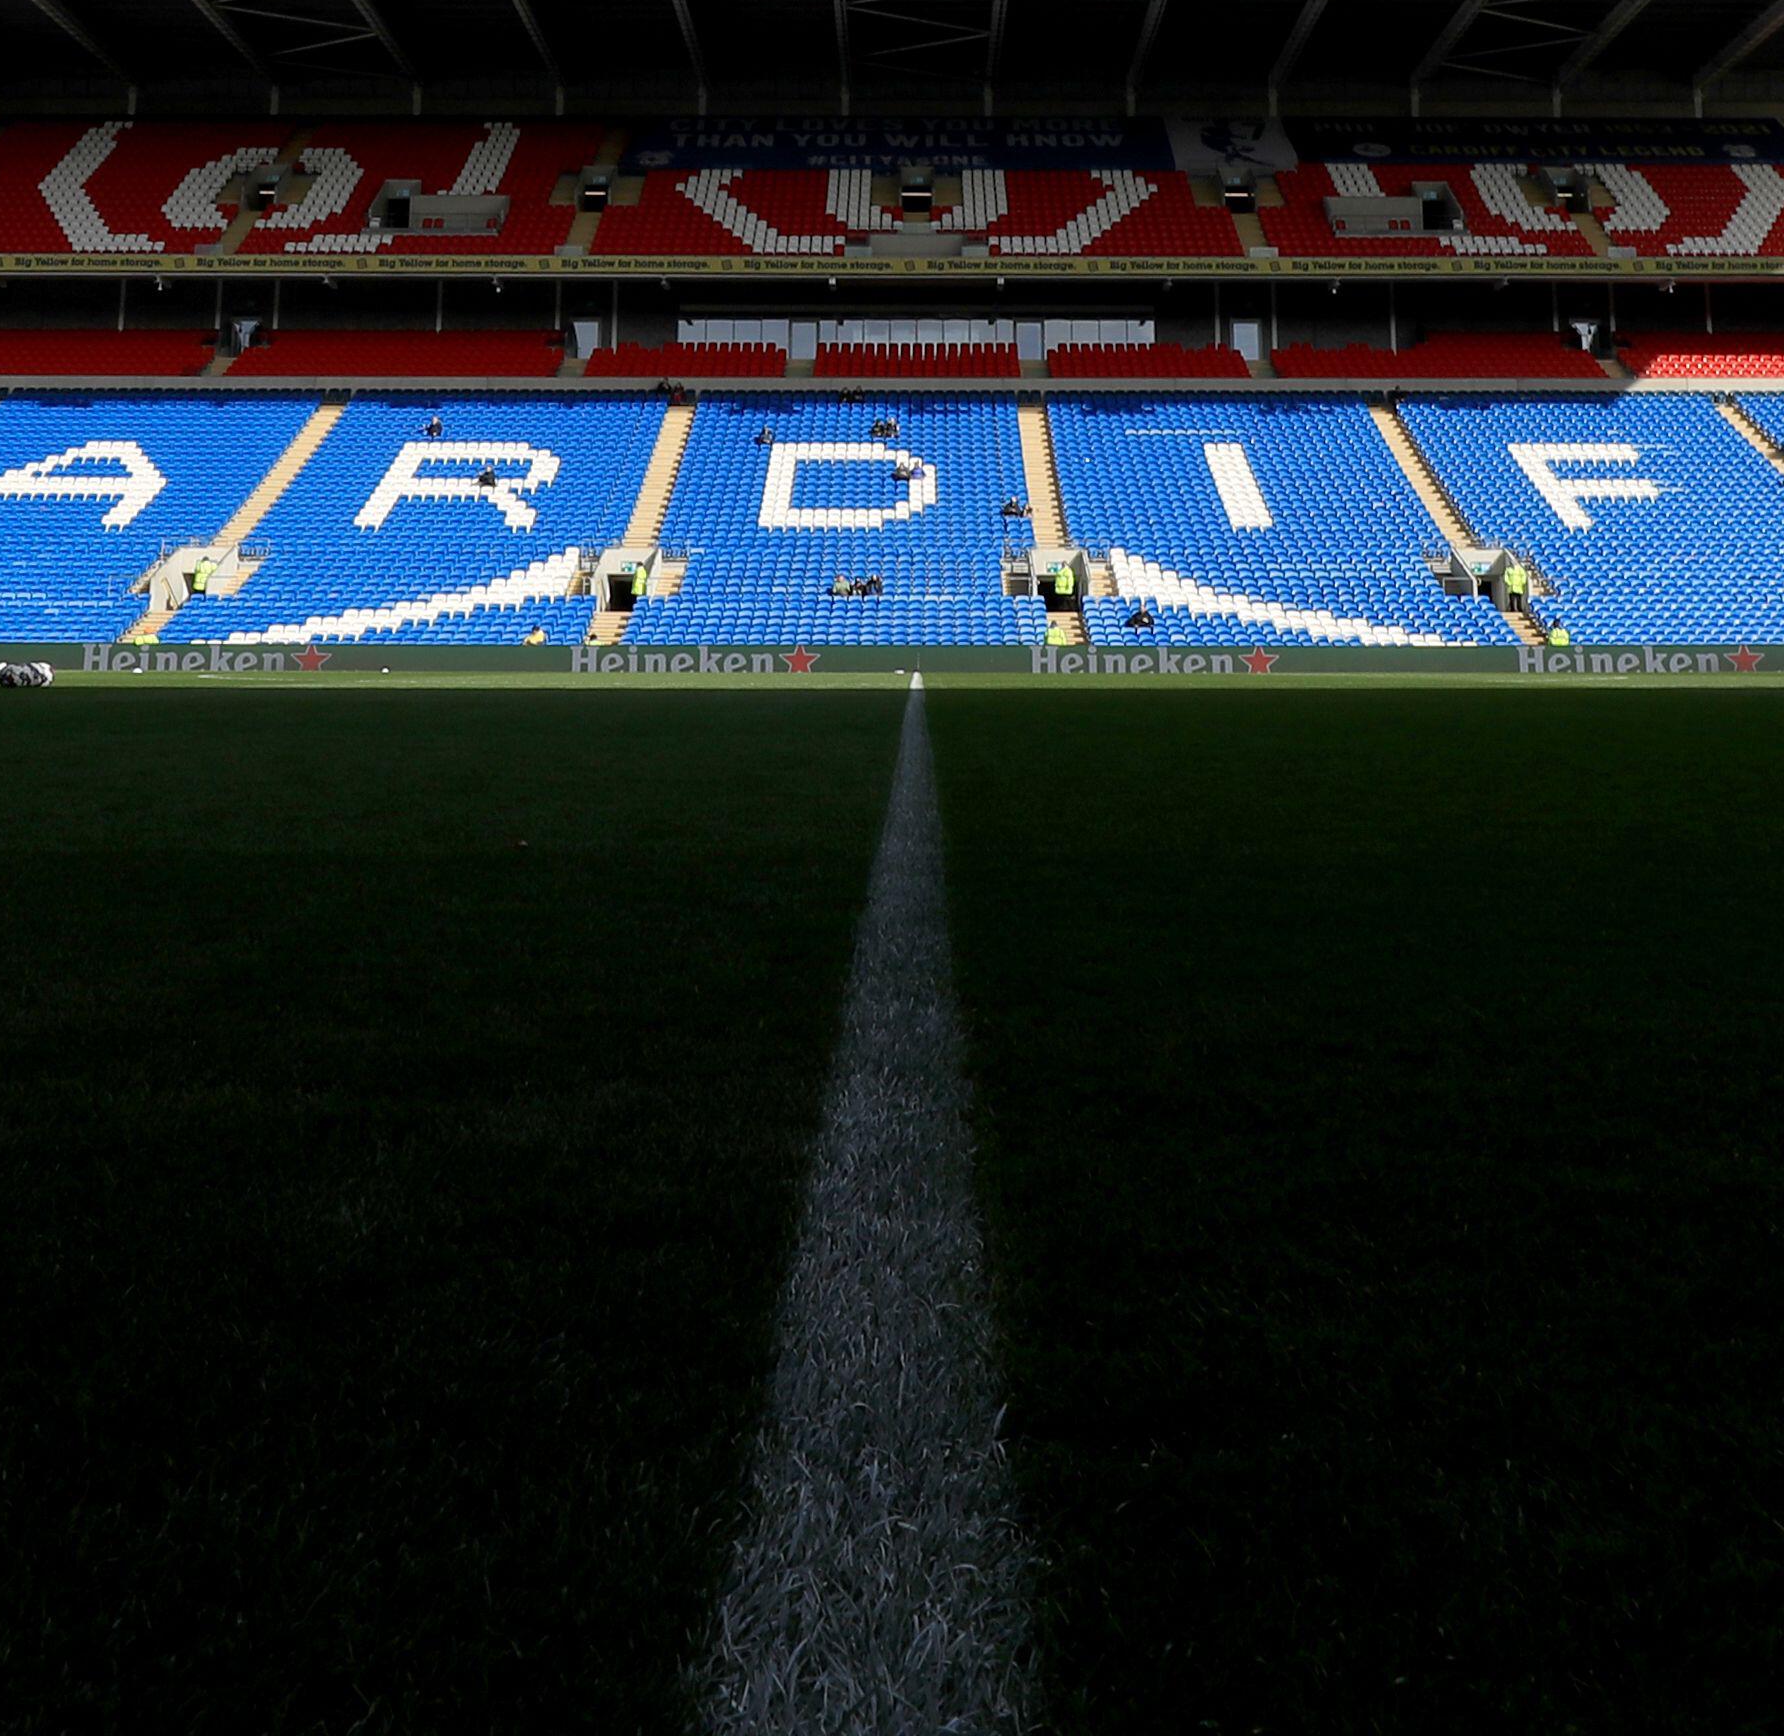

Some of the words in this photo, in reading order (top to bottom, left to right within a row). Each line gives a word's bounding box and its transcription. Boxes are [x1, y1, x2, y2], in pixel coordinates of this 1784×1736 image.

[669, 117, 761, 132] CITY
[920, 117, 995, 132] YOU
[671, 132, 776, 148] THAN
[791, 132, 869, 148] YOU
[882, 132, 991, 148] WILL
[82, 644, 285, 671] Heineken
[570, 645, 774, 672] Heineken
[1030, 645, 1233, 673] Heineken
[1517, 645, 1721, 673] Heineken
